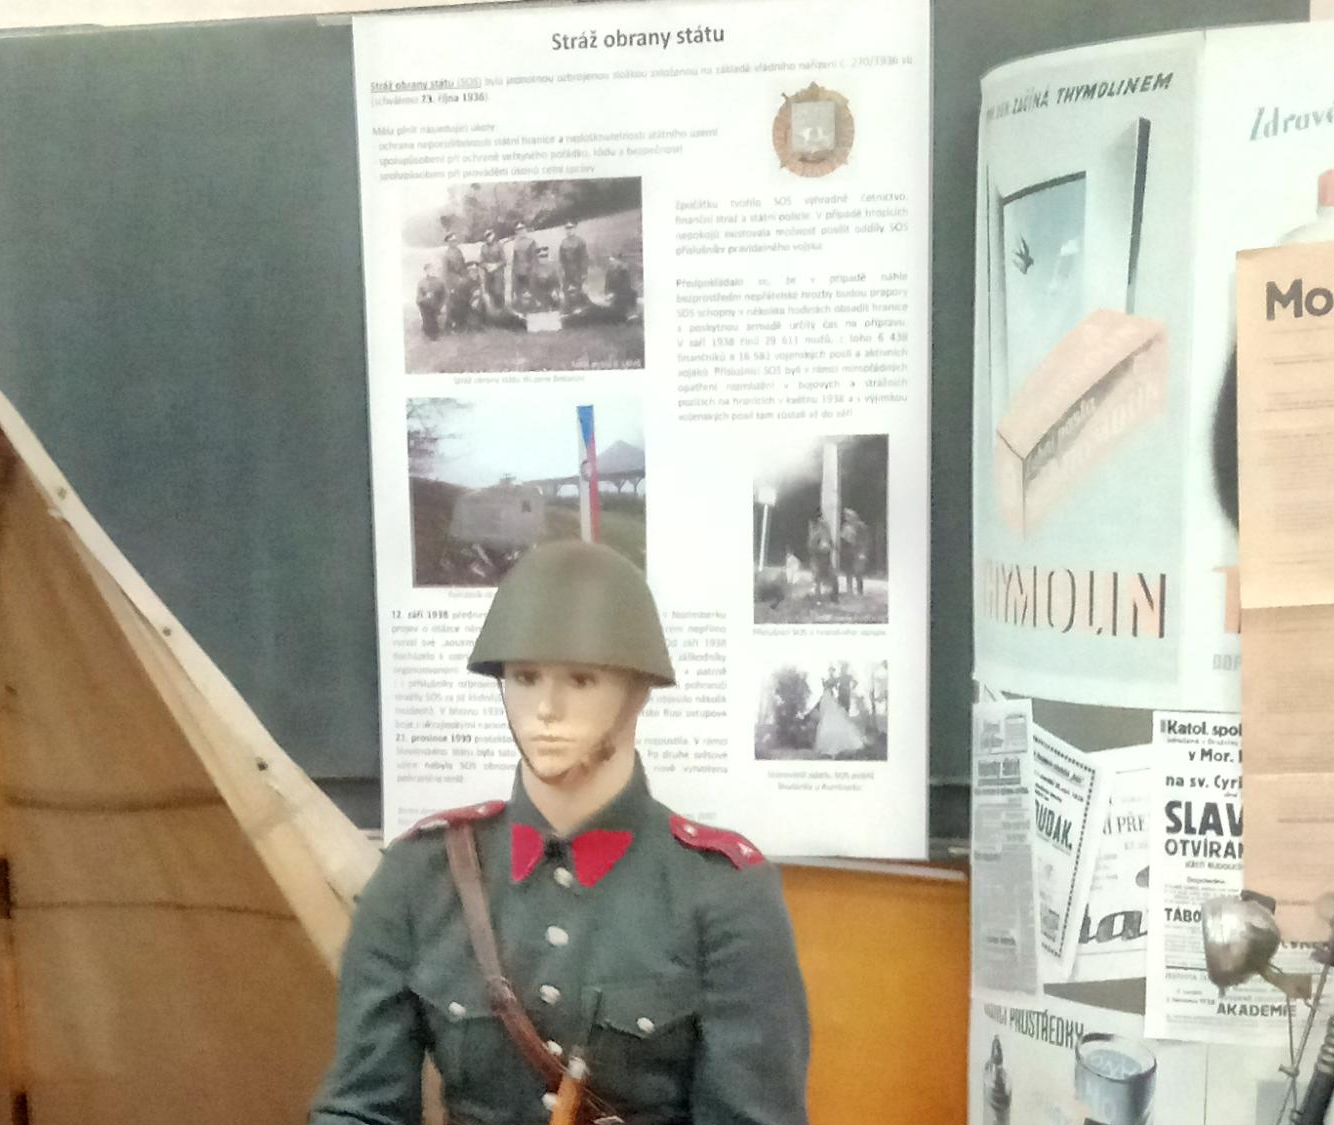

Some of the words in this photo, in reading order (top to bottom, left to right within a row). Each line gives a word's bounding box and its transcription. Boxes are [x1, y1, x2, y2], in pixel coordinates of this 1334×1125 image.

[551, 29, 598, 51] Stráž
[603, 28, 672, 51] obrany
[676, 24, 726, 45] státu
[1056, 72, 1174, 105] THYMOLINEM
[1167, 719, 1209, 735] Katol.
[1188, 750, 1196, 761] v
[1200, 747, 1234, 762] Mor.
[1165, 775, 1184, 787] na
[1189, 777, 1209, 788] sv.
